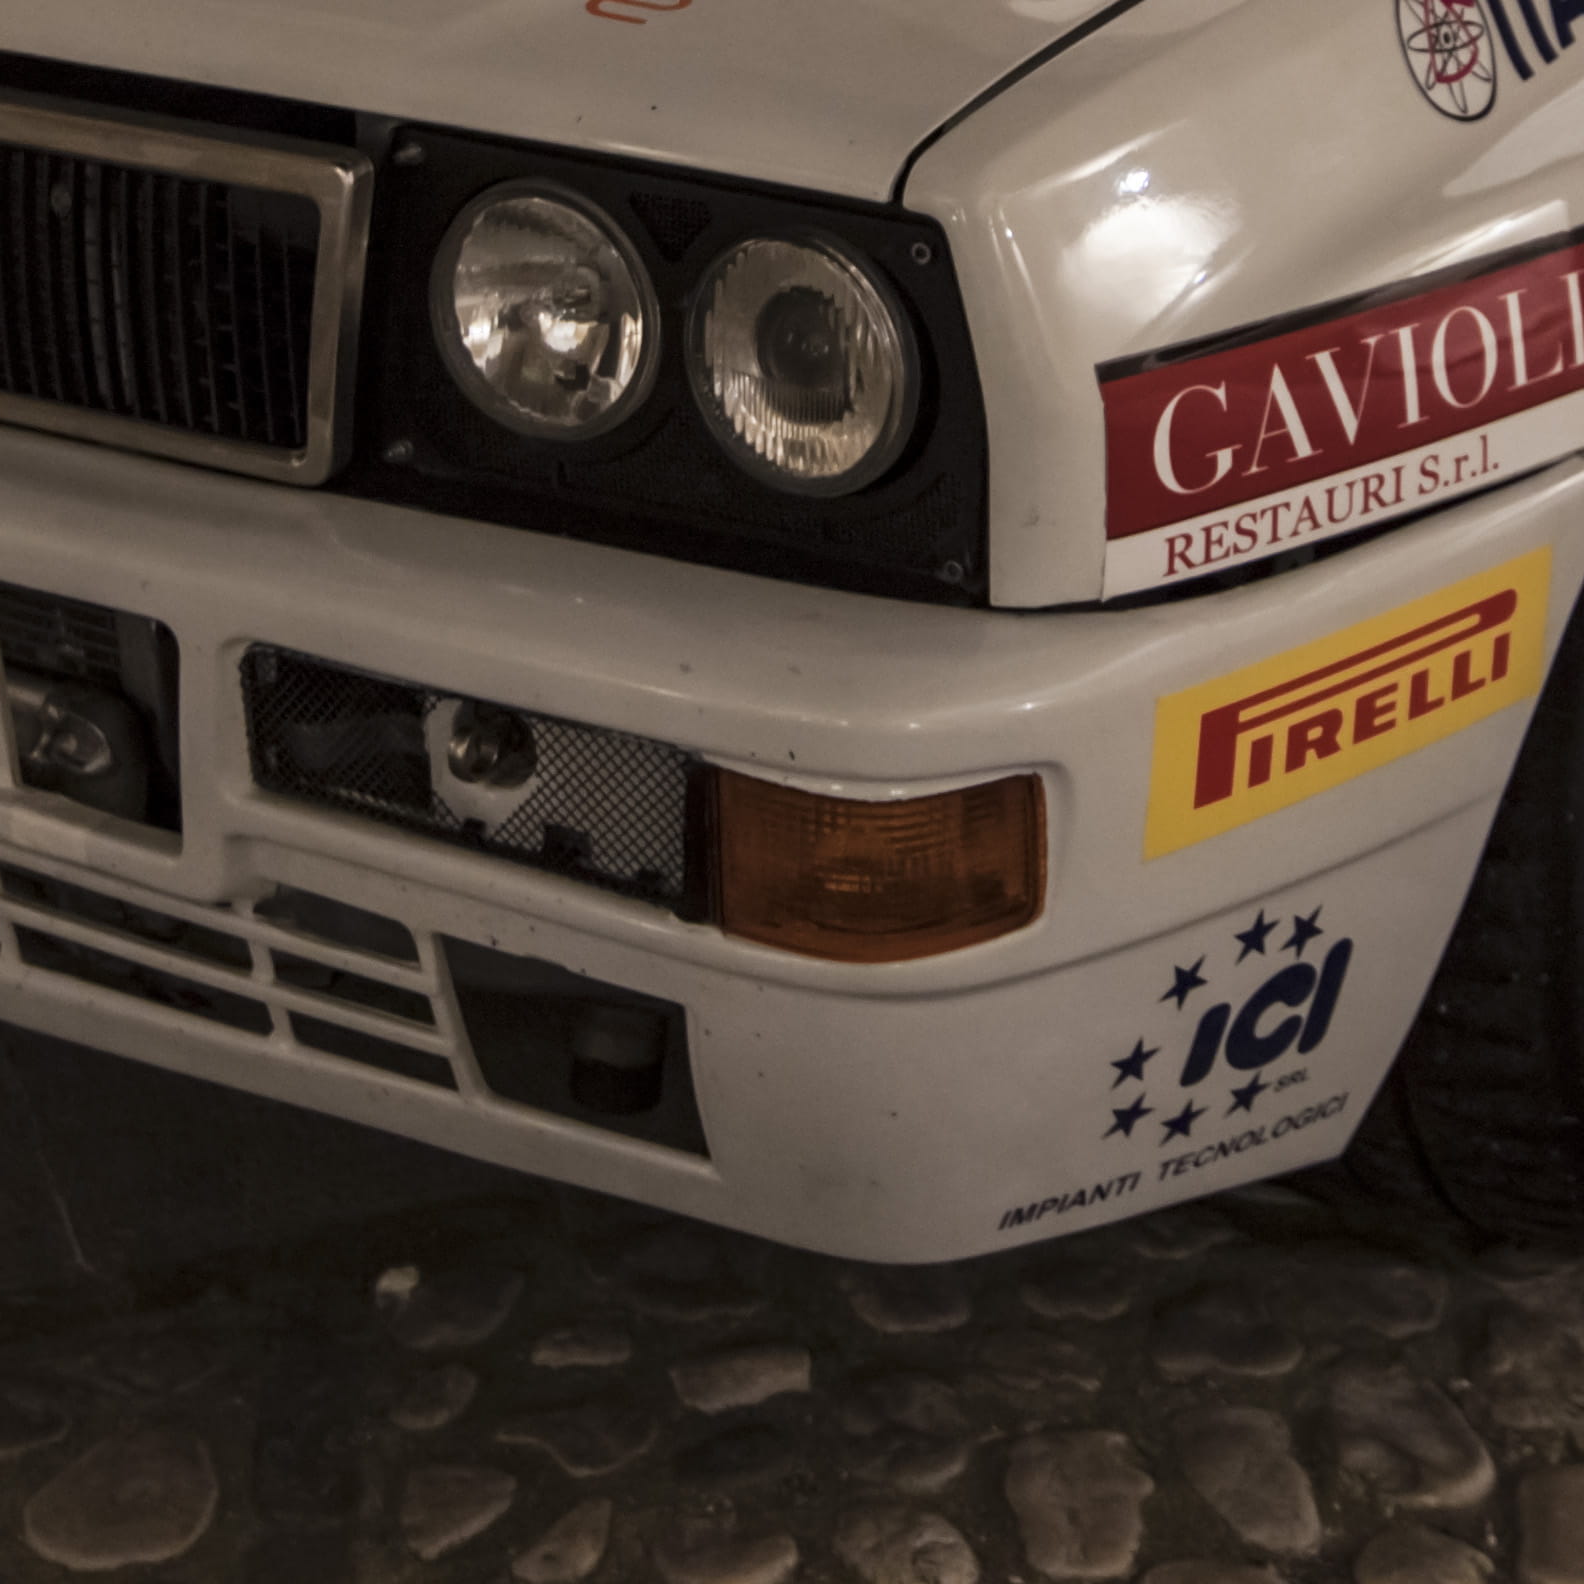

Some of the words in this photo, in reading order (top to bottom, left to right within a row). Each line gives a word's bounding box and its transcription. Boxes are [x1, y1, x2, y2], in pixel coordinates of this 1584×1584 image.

[1162, 465, 1406, 578] RESTAURI
[1417, 434, 1501, 496] S.r.l.
[1192, 587, 1519, 811] PIRELLI
[1179, 936, 1354, 1088] ICI
[996, 1170, 1142, 1231] IMPIANTI
[1157, 1090, 1351, 1183] TECNOLOGICI
